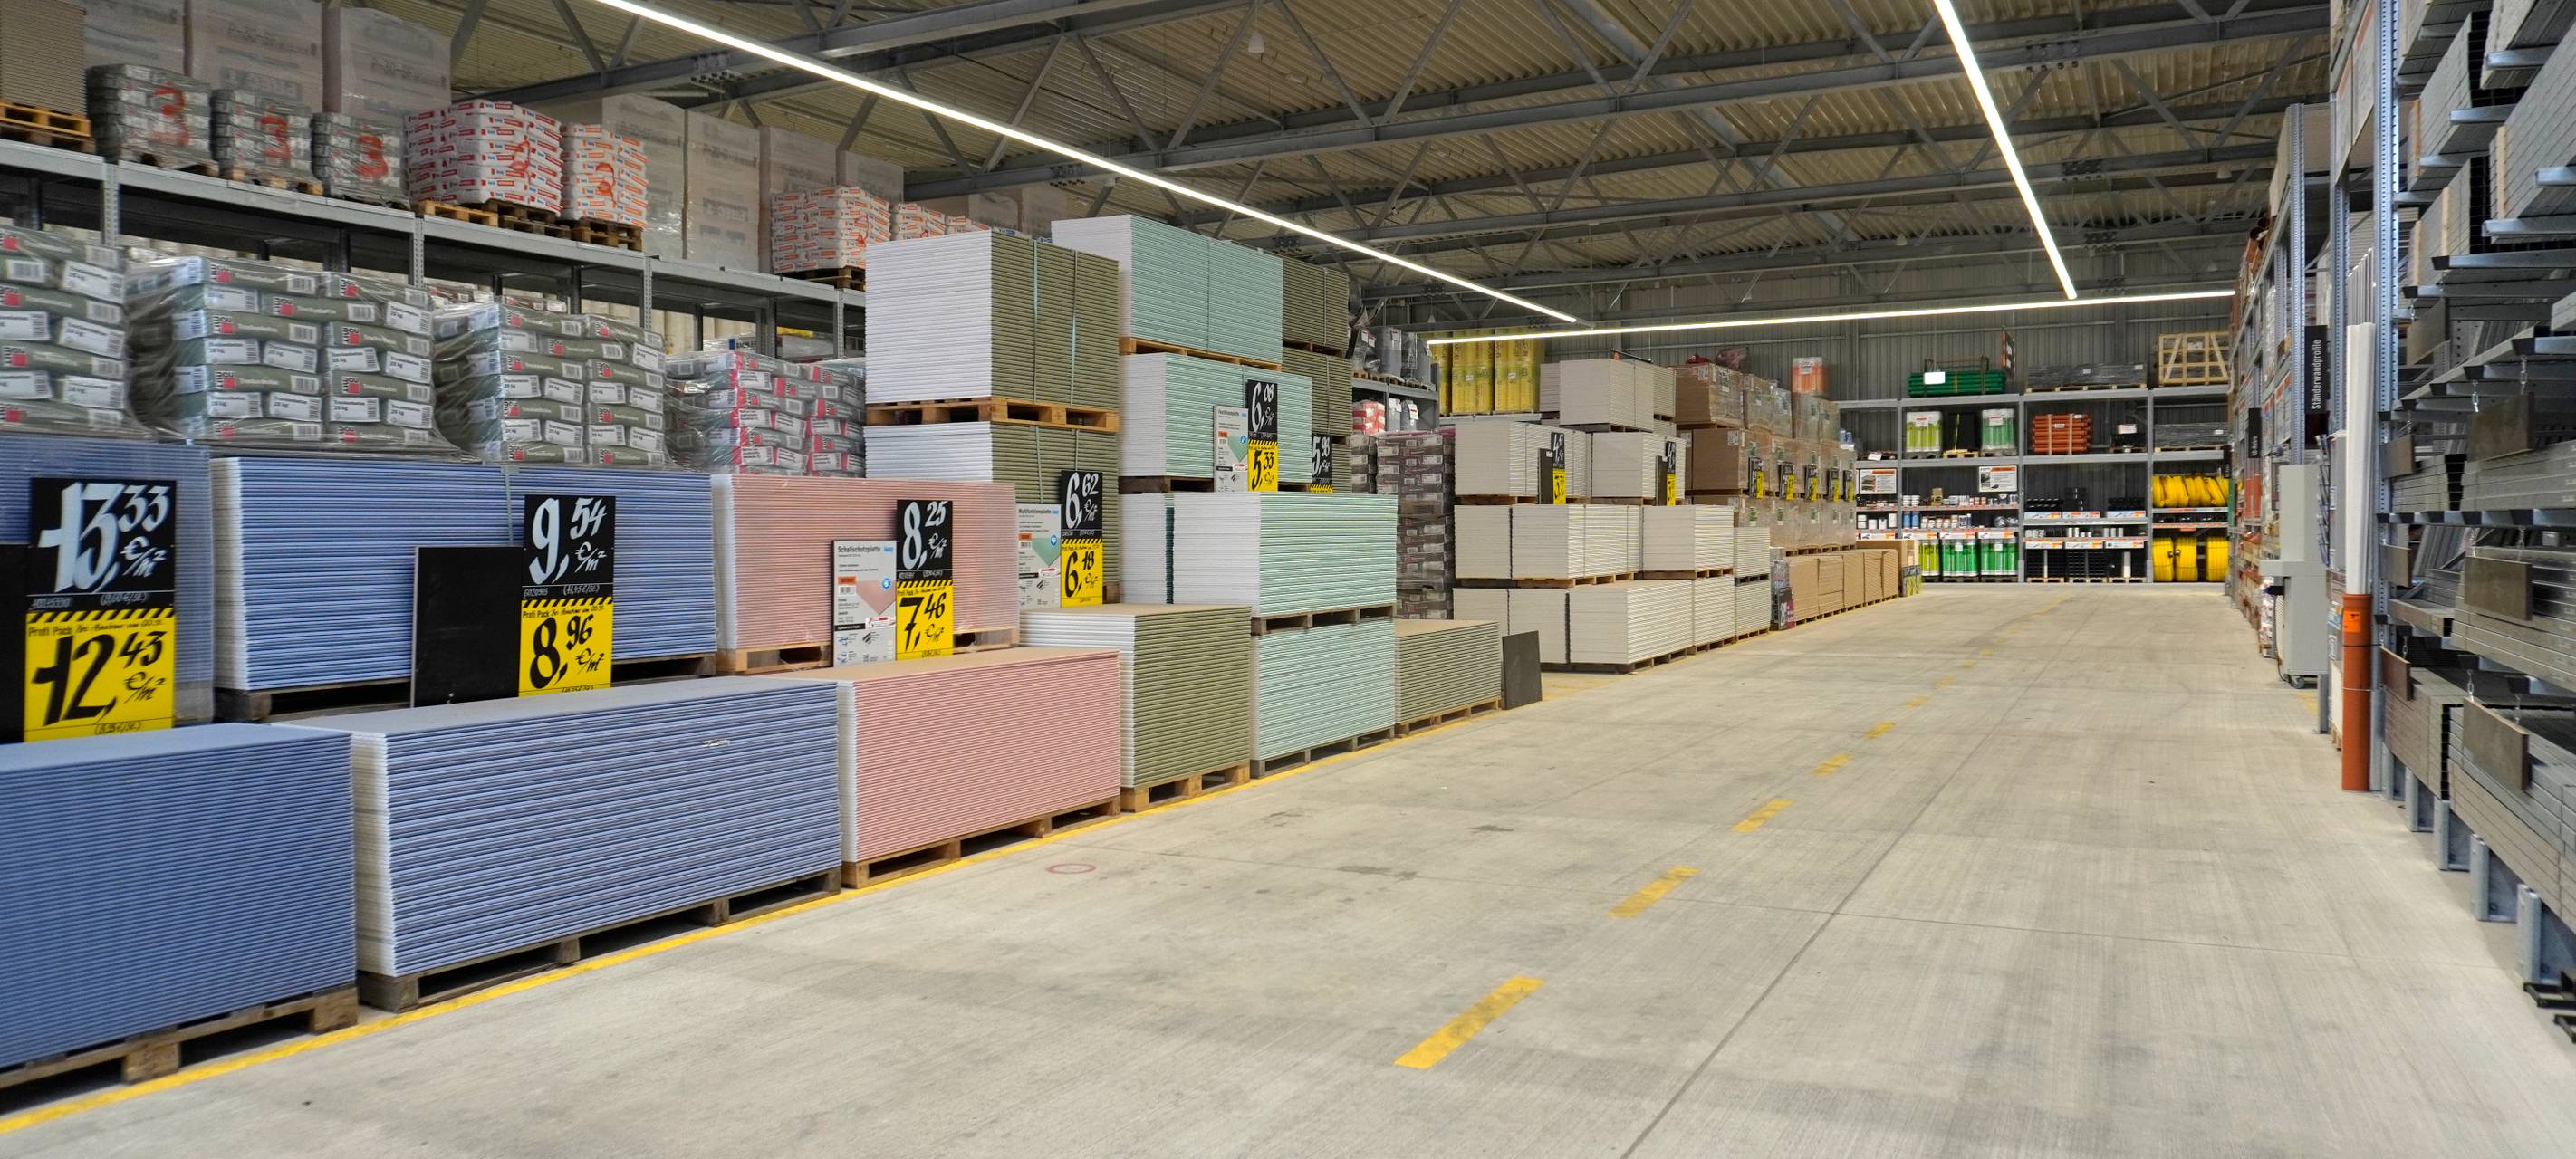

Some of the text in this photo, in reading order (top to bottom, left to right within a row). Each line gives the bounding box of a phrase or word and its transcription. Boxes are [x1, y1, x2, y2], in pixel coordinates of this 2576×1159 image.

[2312, 340, 2322, 409] Ständerwandprofile
[902, 500, 948, 570] 8,25
[1065, 472, 1099, 529] 6,62
[38, 482, 170, 593] 13,33
[529, 497, 607, 585] 9,54
[529, 613, 594, 689] 8,96
[899, 592, 947, 653] 7,46
[32, 631, 167, 725] 12,43
